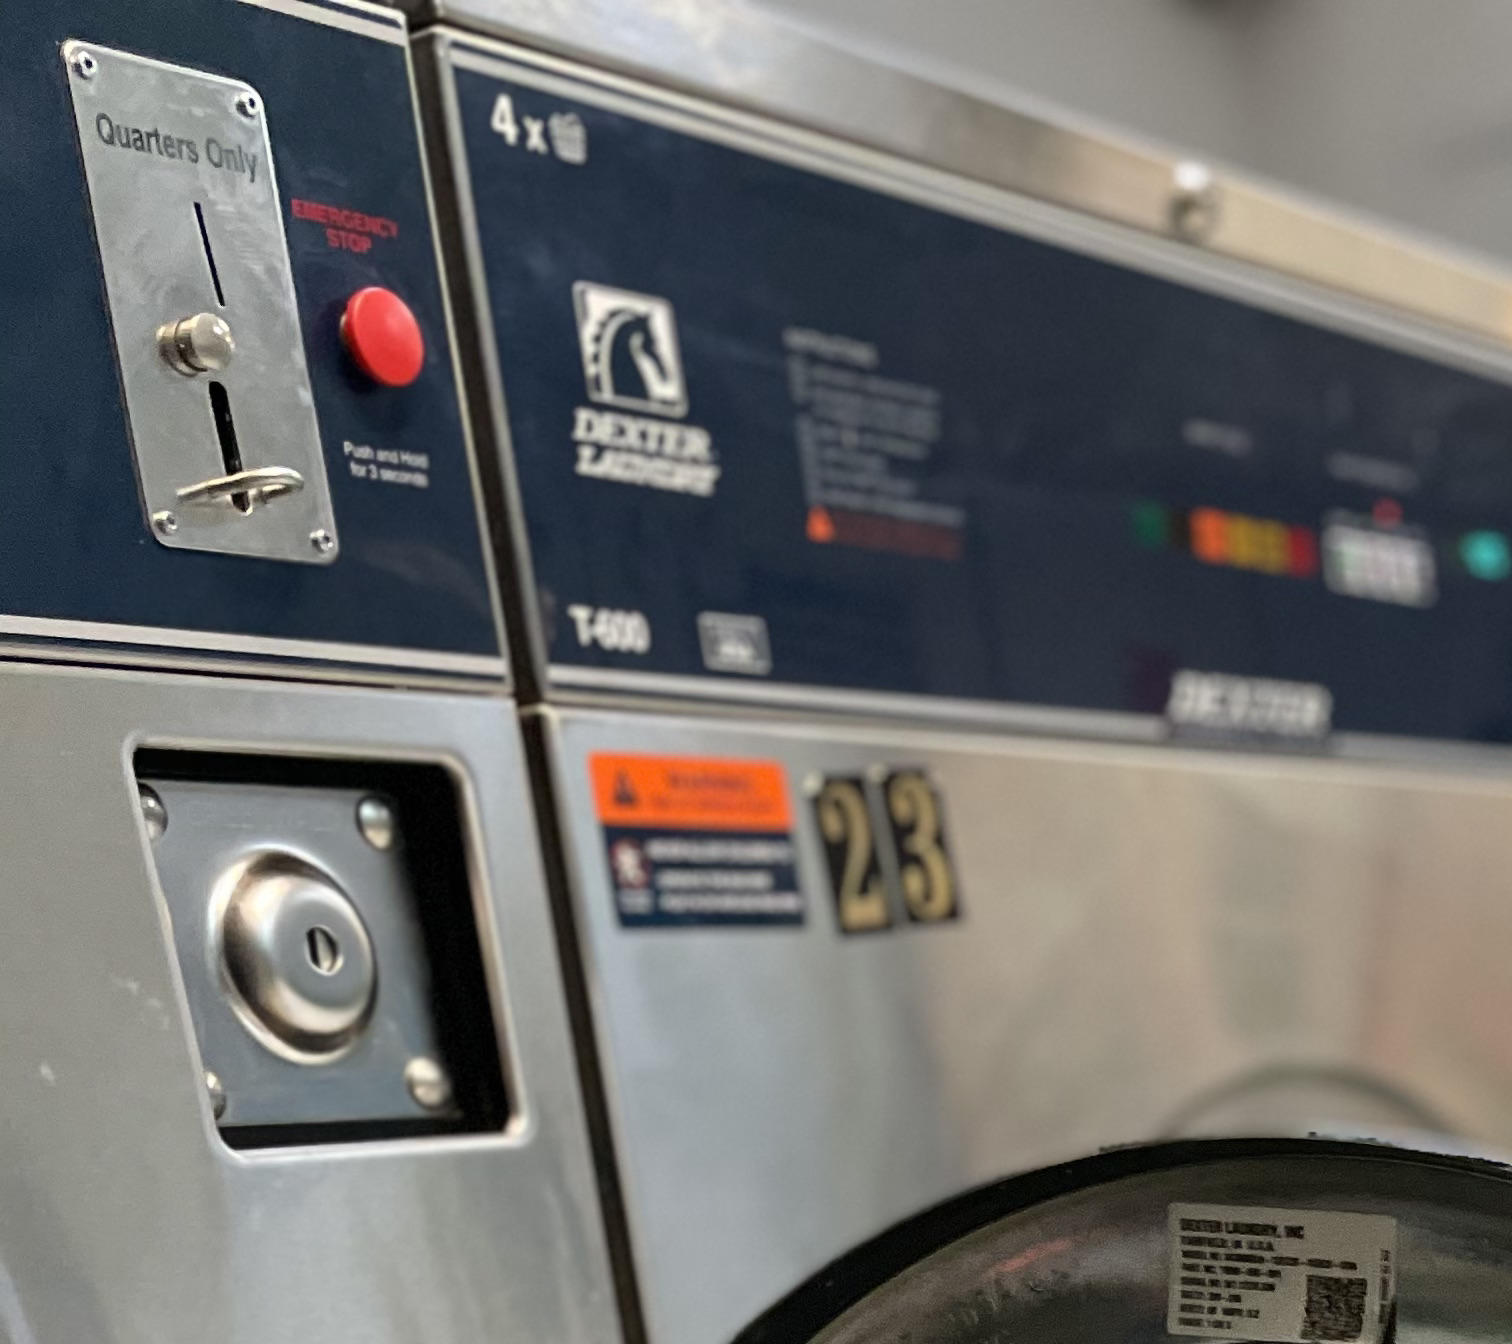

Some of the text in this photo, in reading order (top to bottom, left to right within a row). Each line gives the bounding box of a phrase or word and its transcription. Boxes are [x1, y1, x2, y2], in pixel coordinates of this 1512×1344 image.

[490, 92, 520, 147] 4
[95, 112, 258, 184] Quarters Only
[291, 198, 399, 239] EMERGENCY
[326, 227, 372, 254] STOP
[343, 441, 429, 471] Push and Hold
[350, 460, 367, 477] for
[368, 463, 378, 480] 3
